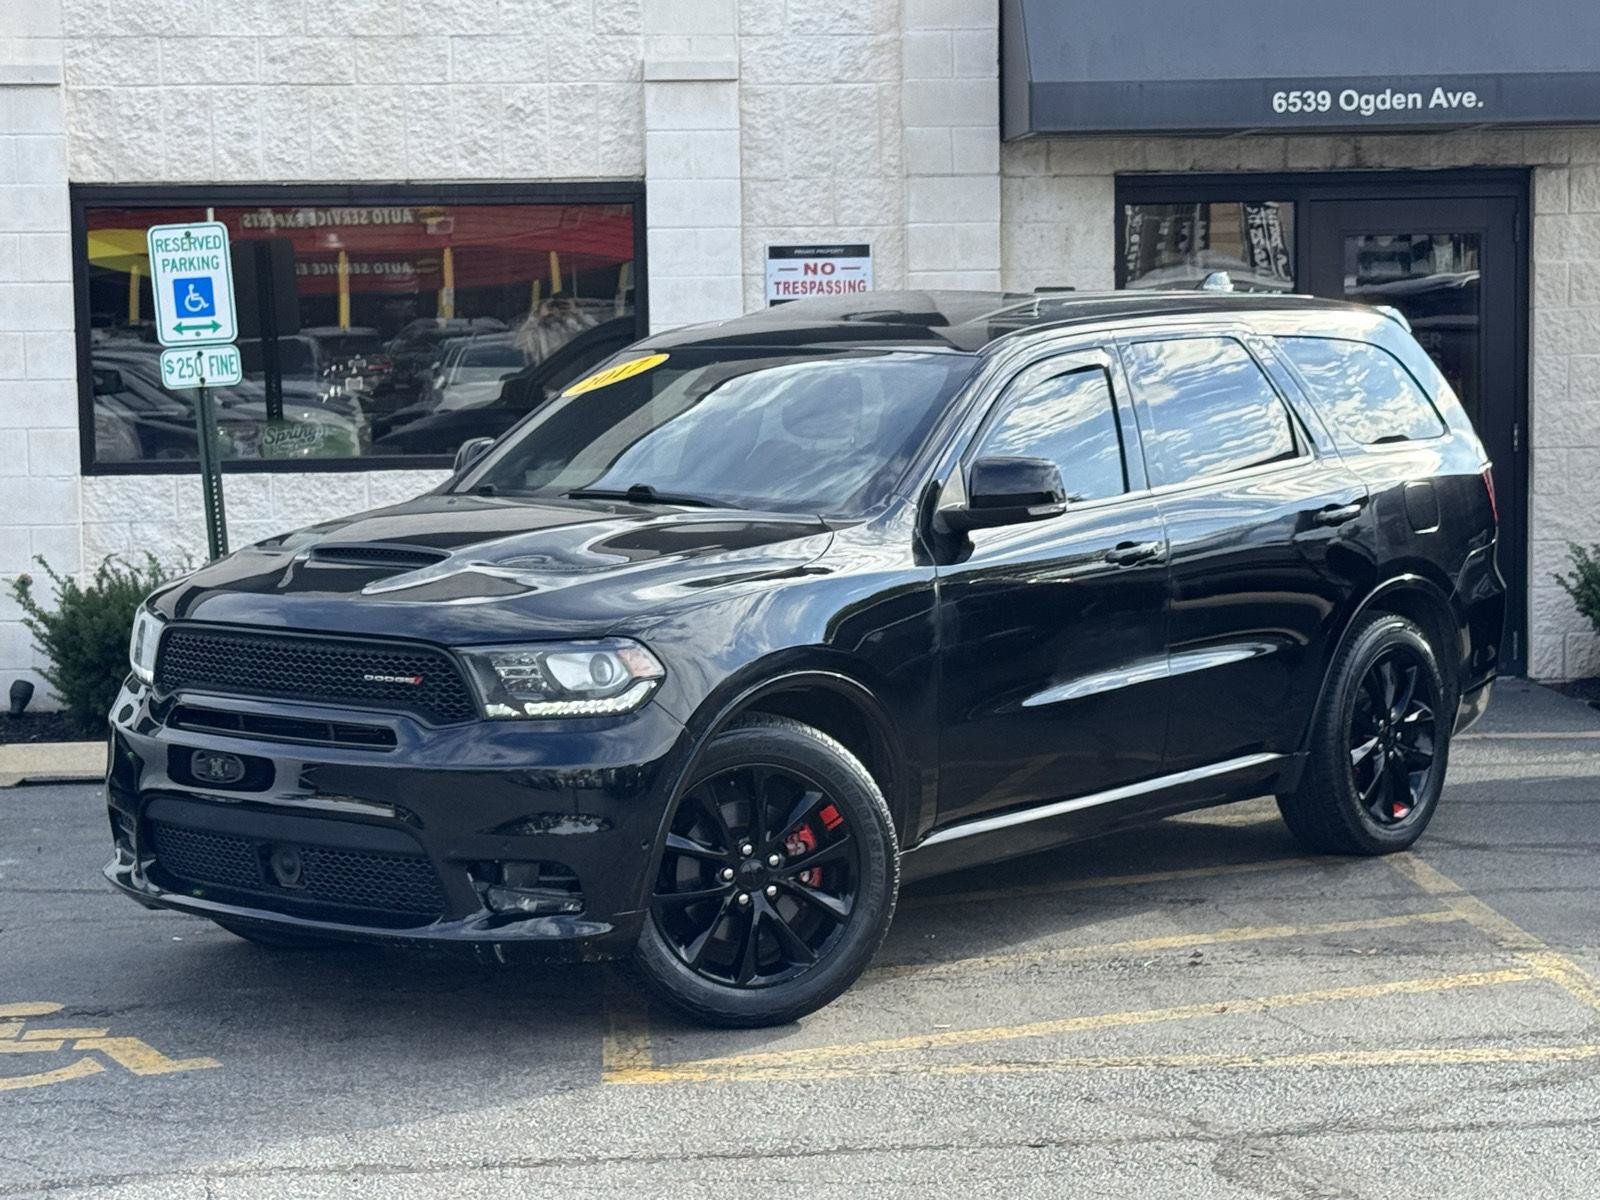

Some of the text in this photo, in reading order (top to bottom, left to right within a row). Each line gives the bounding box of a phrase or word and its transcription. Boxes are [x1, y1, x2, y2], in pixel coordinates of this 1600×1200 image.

[1272, 87, 1484, 116] 6539 Ogden Ave.
[155, 235, 222, 253] RESERVED
[162, 255, 220, 273] PARKING
[803, 262, 835, 276] NO
[774, 280, 867, 295] TRESPASSING
[208, 354, 237, 376] FINE
[364, 674, 415, 683] DODGE
